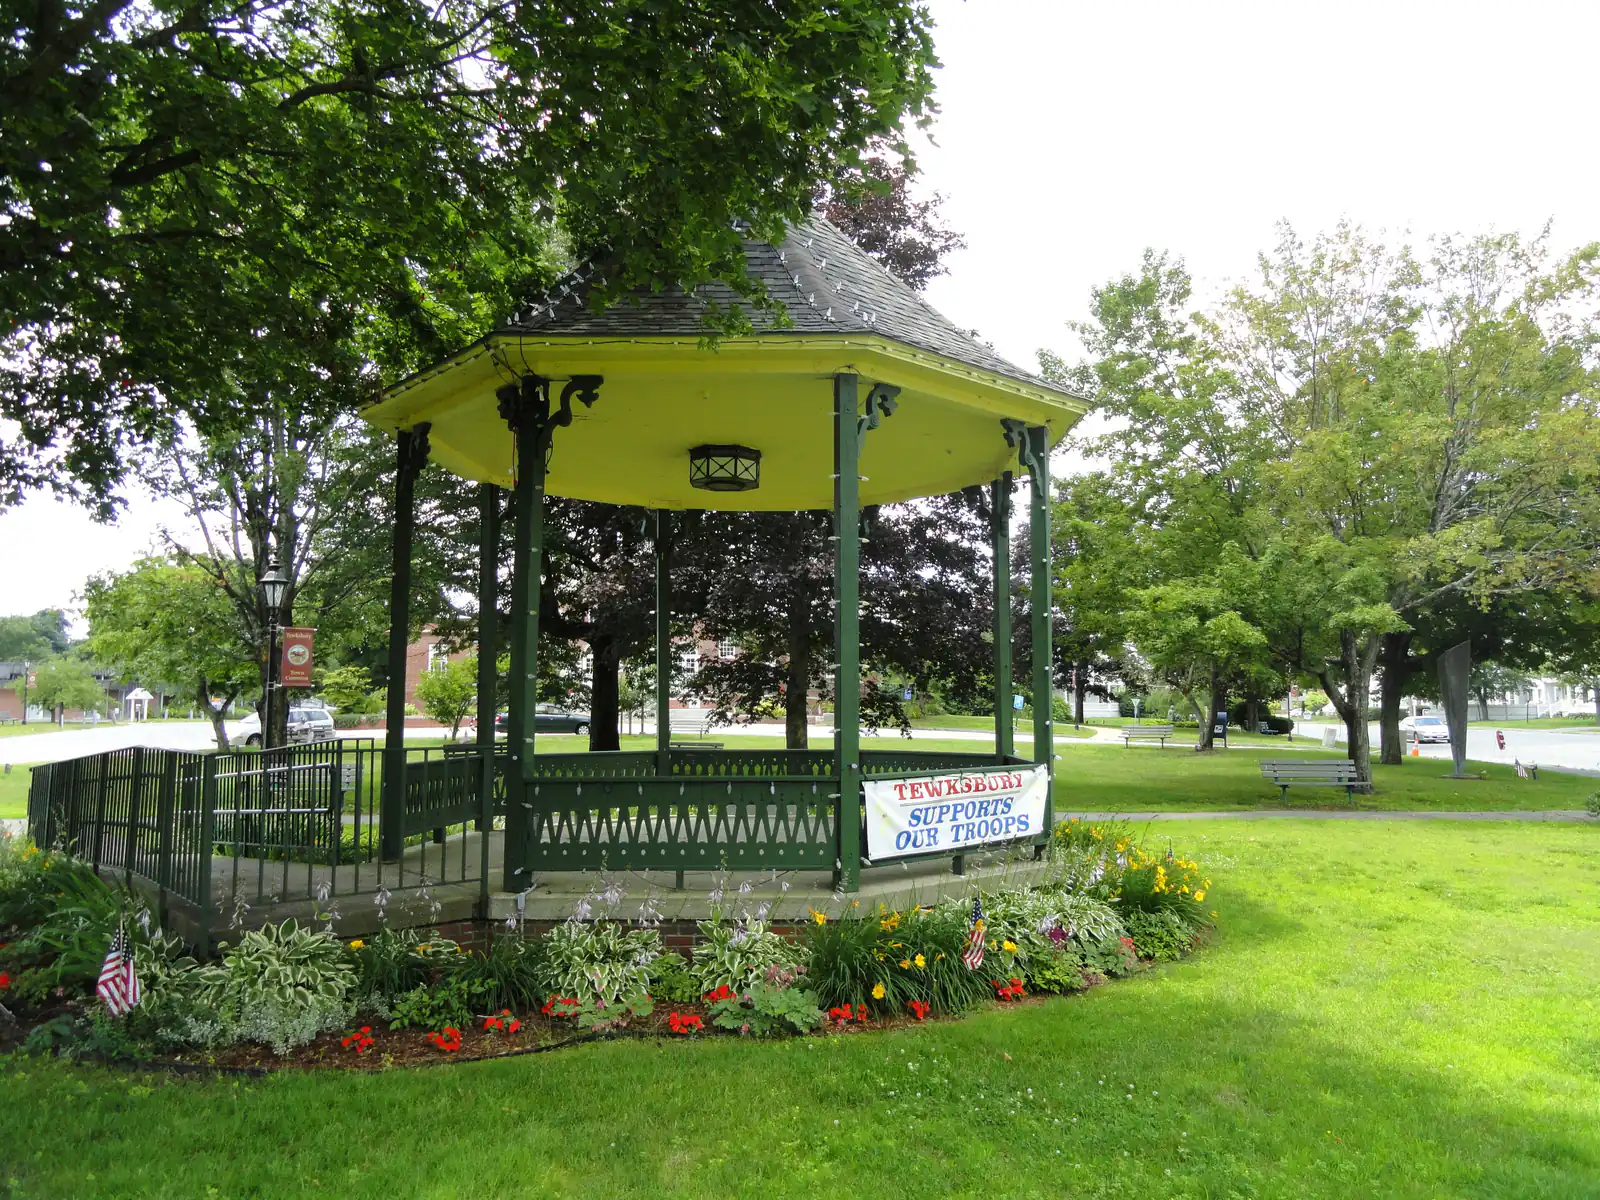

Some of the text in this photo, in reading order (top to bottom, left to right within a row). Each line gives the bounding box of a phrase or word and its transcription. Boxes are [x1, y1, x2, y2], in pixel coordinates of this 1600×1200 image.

[894, 774, 1023, 800] TEWKSBURY
[908, 797, 1014, 827] SUPPORTS
[895, 814, 1029, 850] OUR TROOPS
